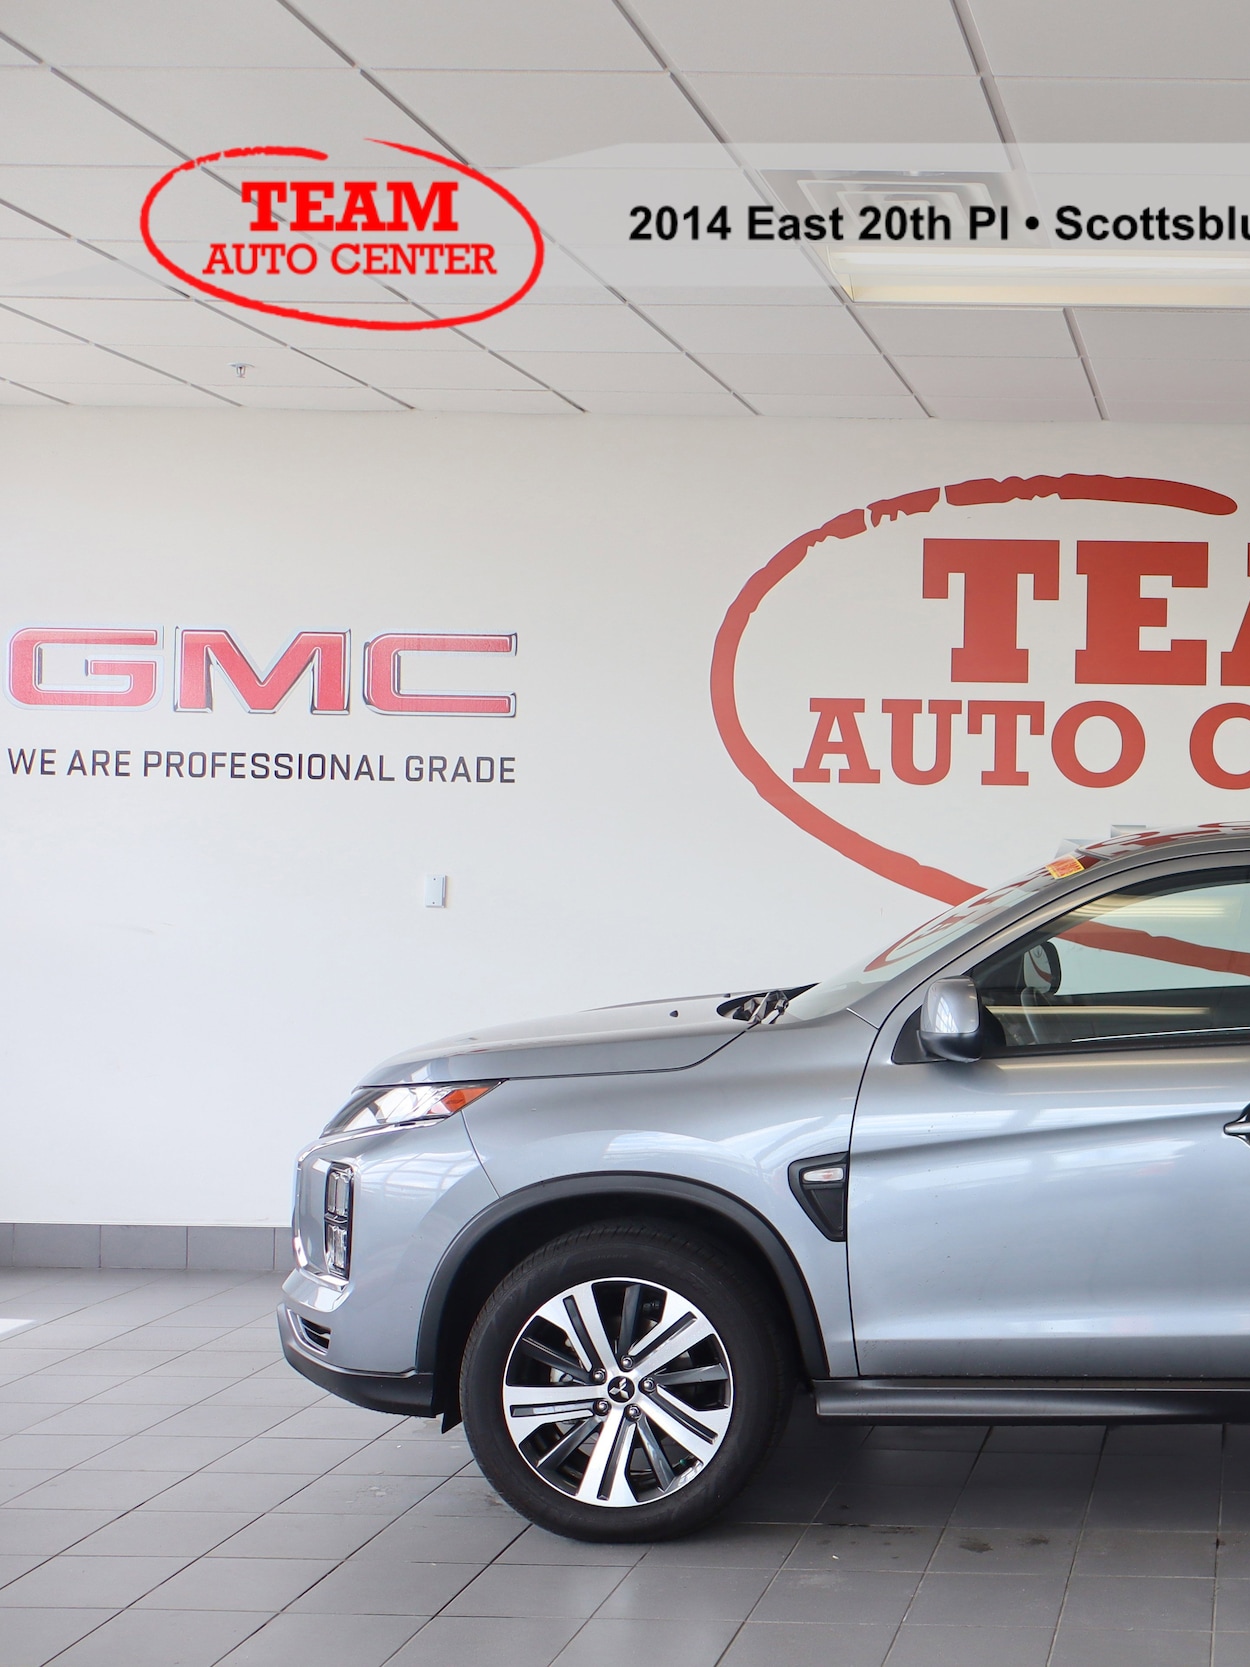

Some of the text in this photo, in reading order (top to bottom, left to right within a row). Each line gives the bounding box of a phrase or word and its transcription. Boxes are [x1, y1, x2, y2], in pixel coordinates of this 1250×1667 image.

[5, 624, 519, 718] GMC
[7, 748, 516, 784] WE ARE PROFESSIONAL GRADE
[792, 697, 1146, 787] AUTO
